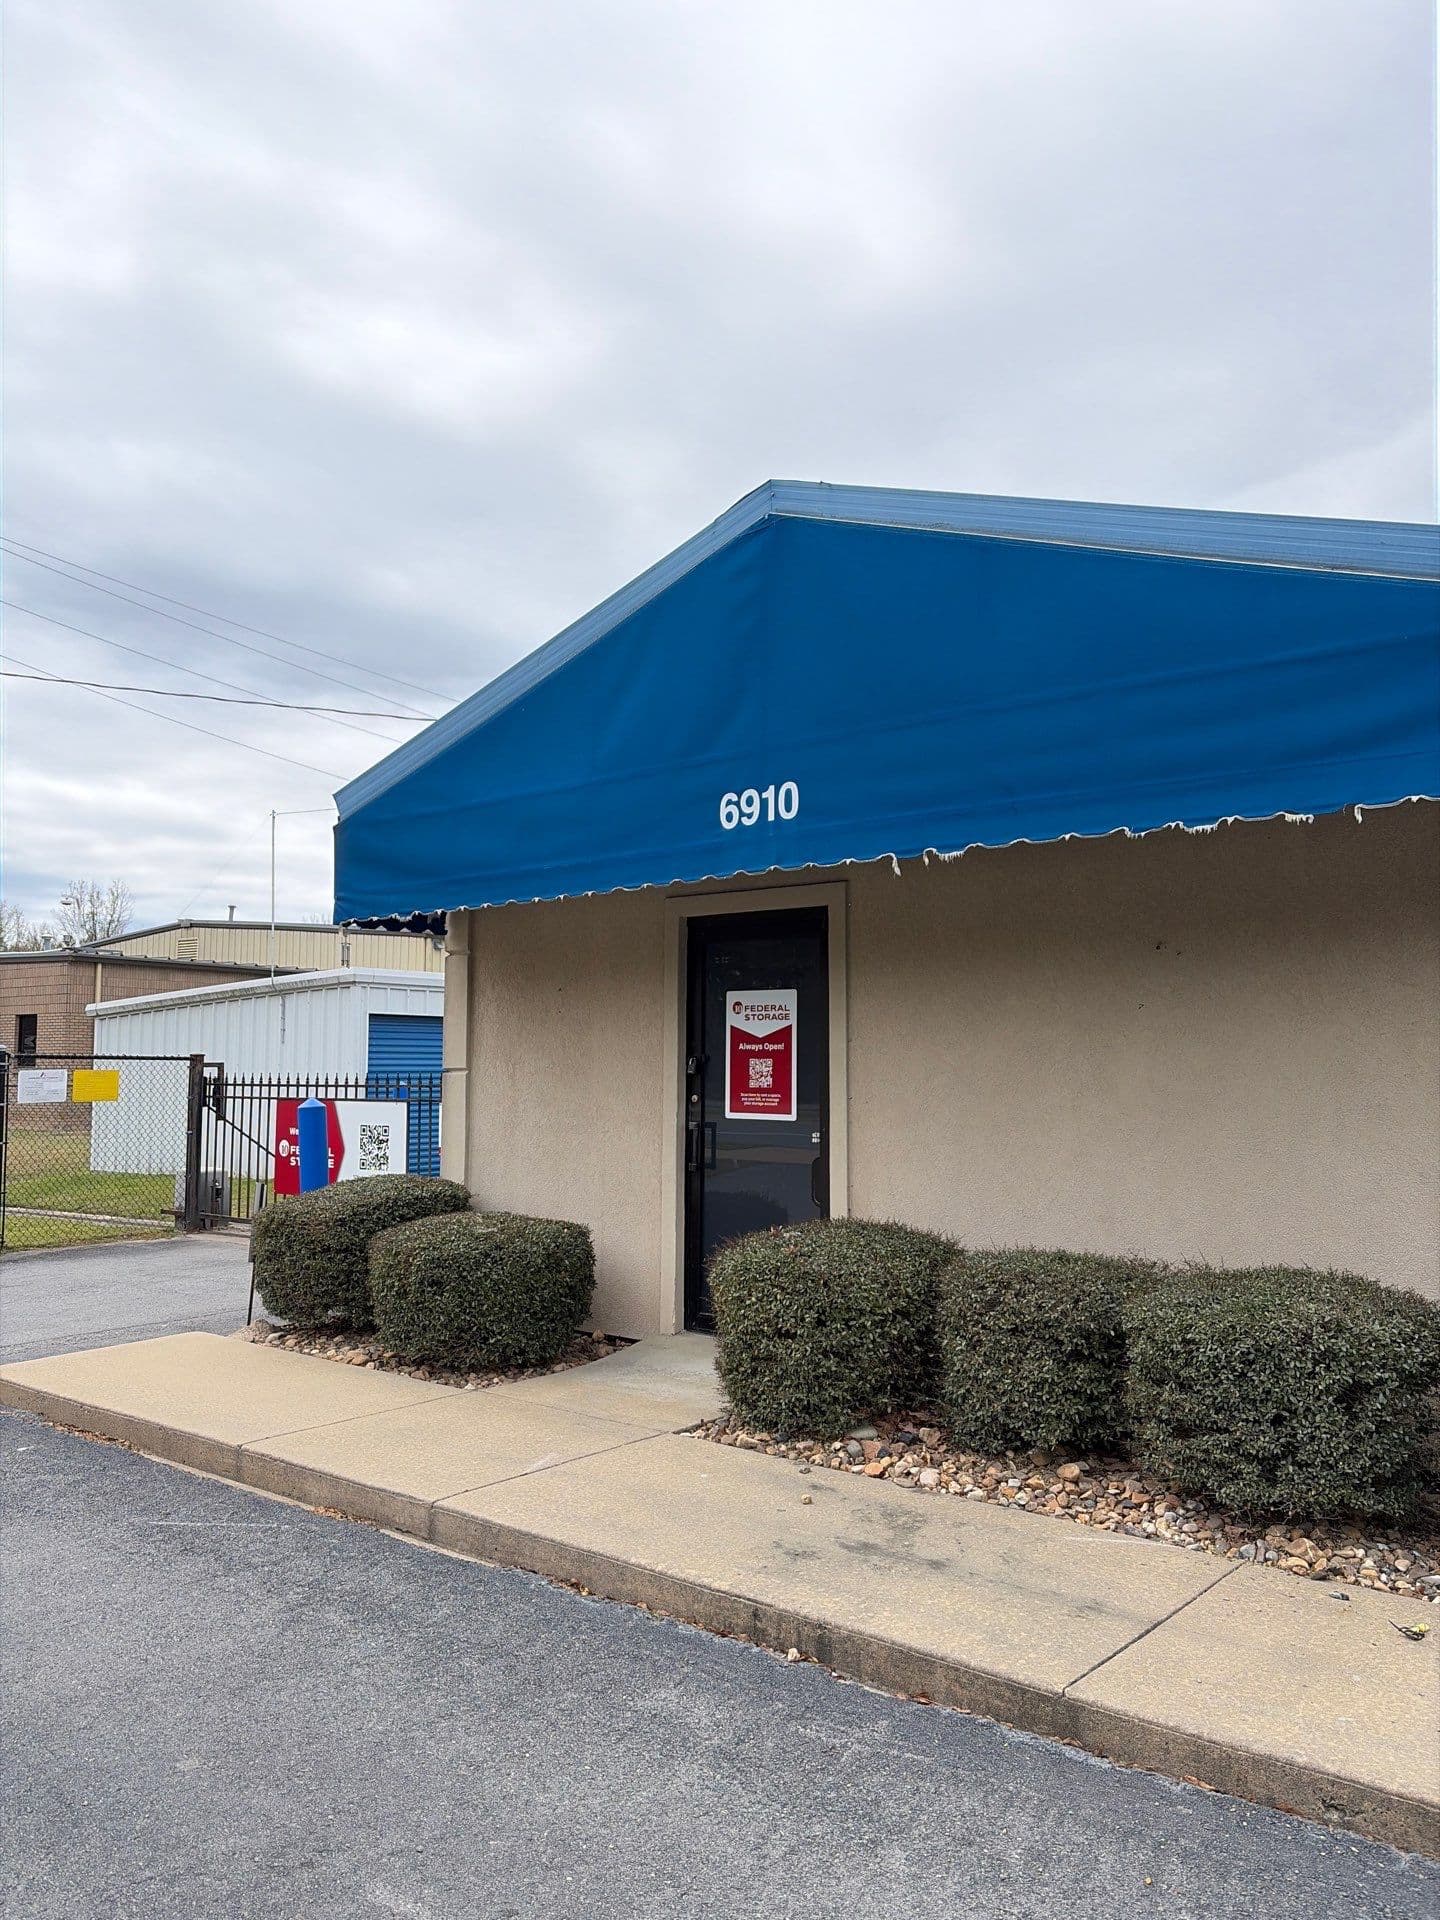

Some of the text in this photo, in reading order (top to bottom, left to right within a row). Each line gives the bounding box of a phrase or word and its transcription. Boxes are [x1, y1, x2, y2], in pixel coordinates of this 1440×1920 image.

[720, 781, 799, 830] 6910
[744, 1004, 790, 1012] FEDERAL
[744, 1013, 790, 1021] STORAGE
[738, 1042, 785, 1051] Always Open!
